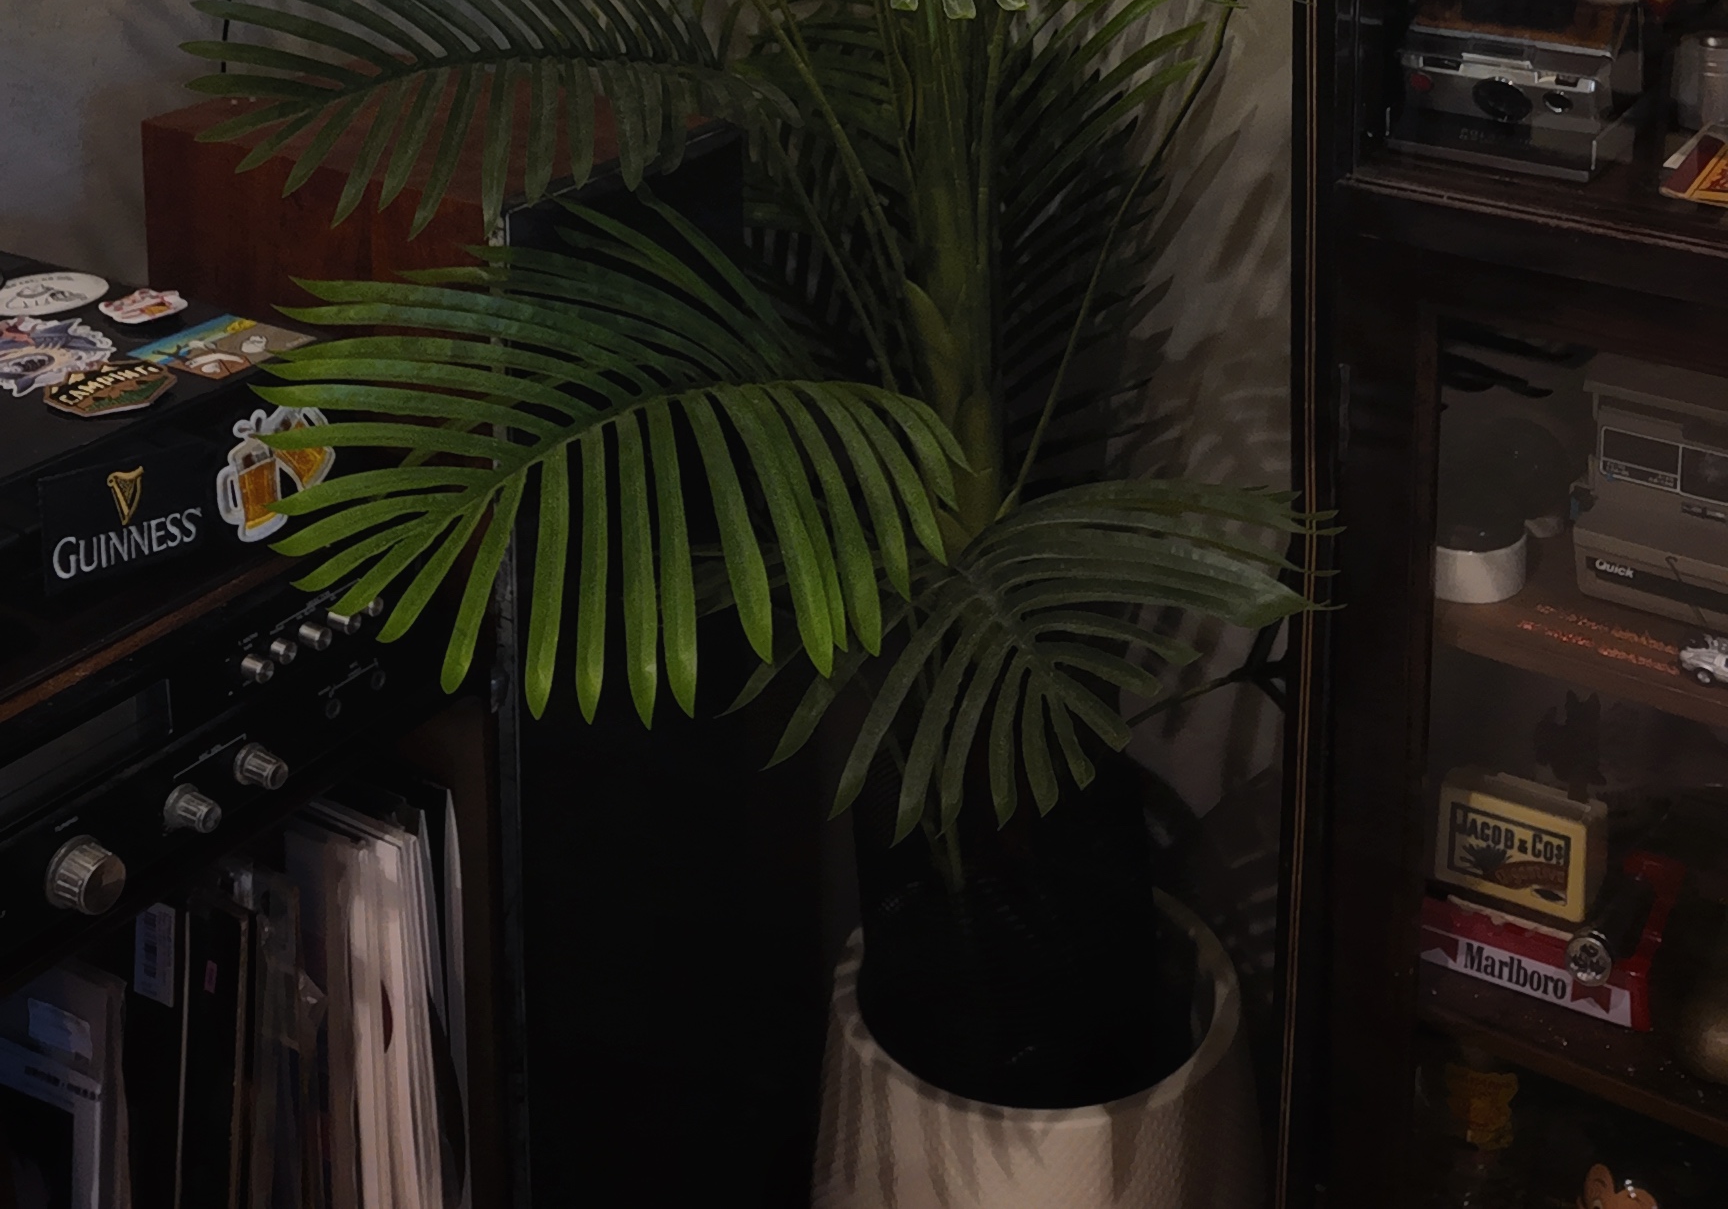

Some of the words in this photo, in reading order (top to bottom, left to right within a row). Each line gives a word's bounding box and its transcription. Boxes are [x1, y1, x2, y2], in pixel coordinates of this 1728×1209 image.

[53, 509, 201, 580] GUINNESS
[1595, 558, 1635, 578] Quick
[1455, 808, 1515, 850] JACOB
[1517, 837, 1528, 854] &
[1463, 943, 1567, 1000] Marlboro
